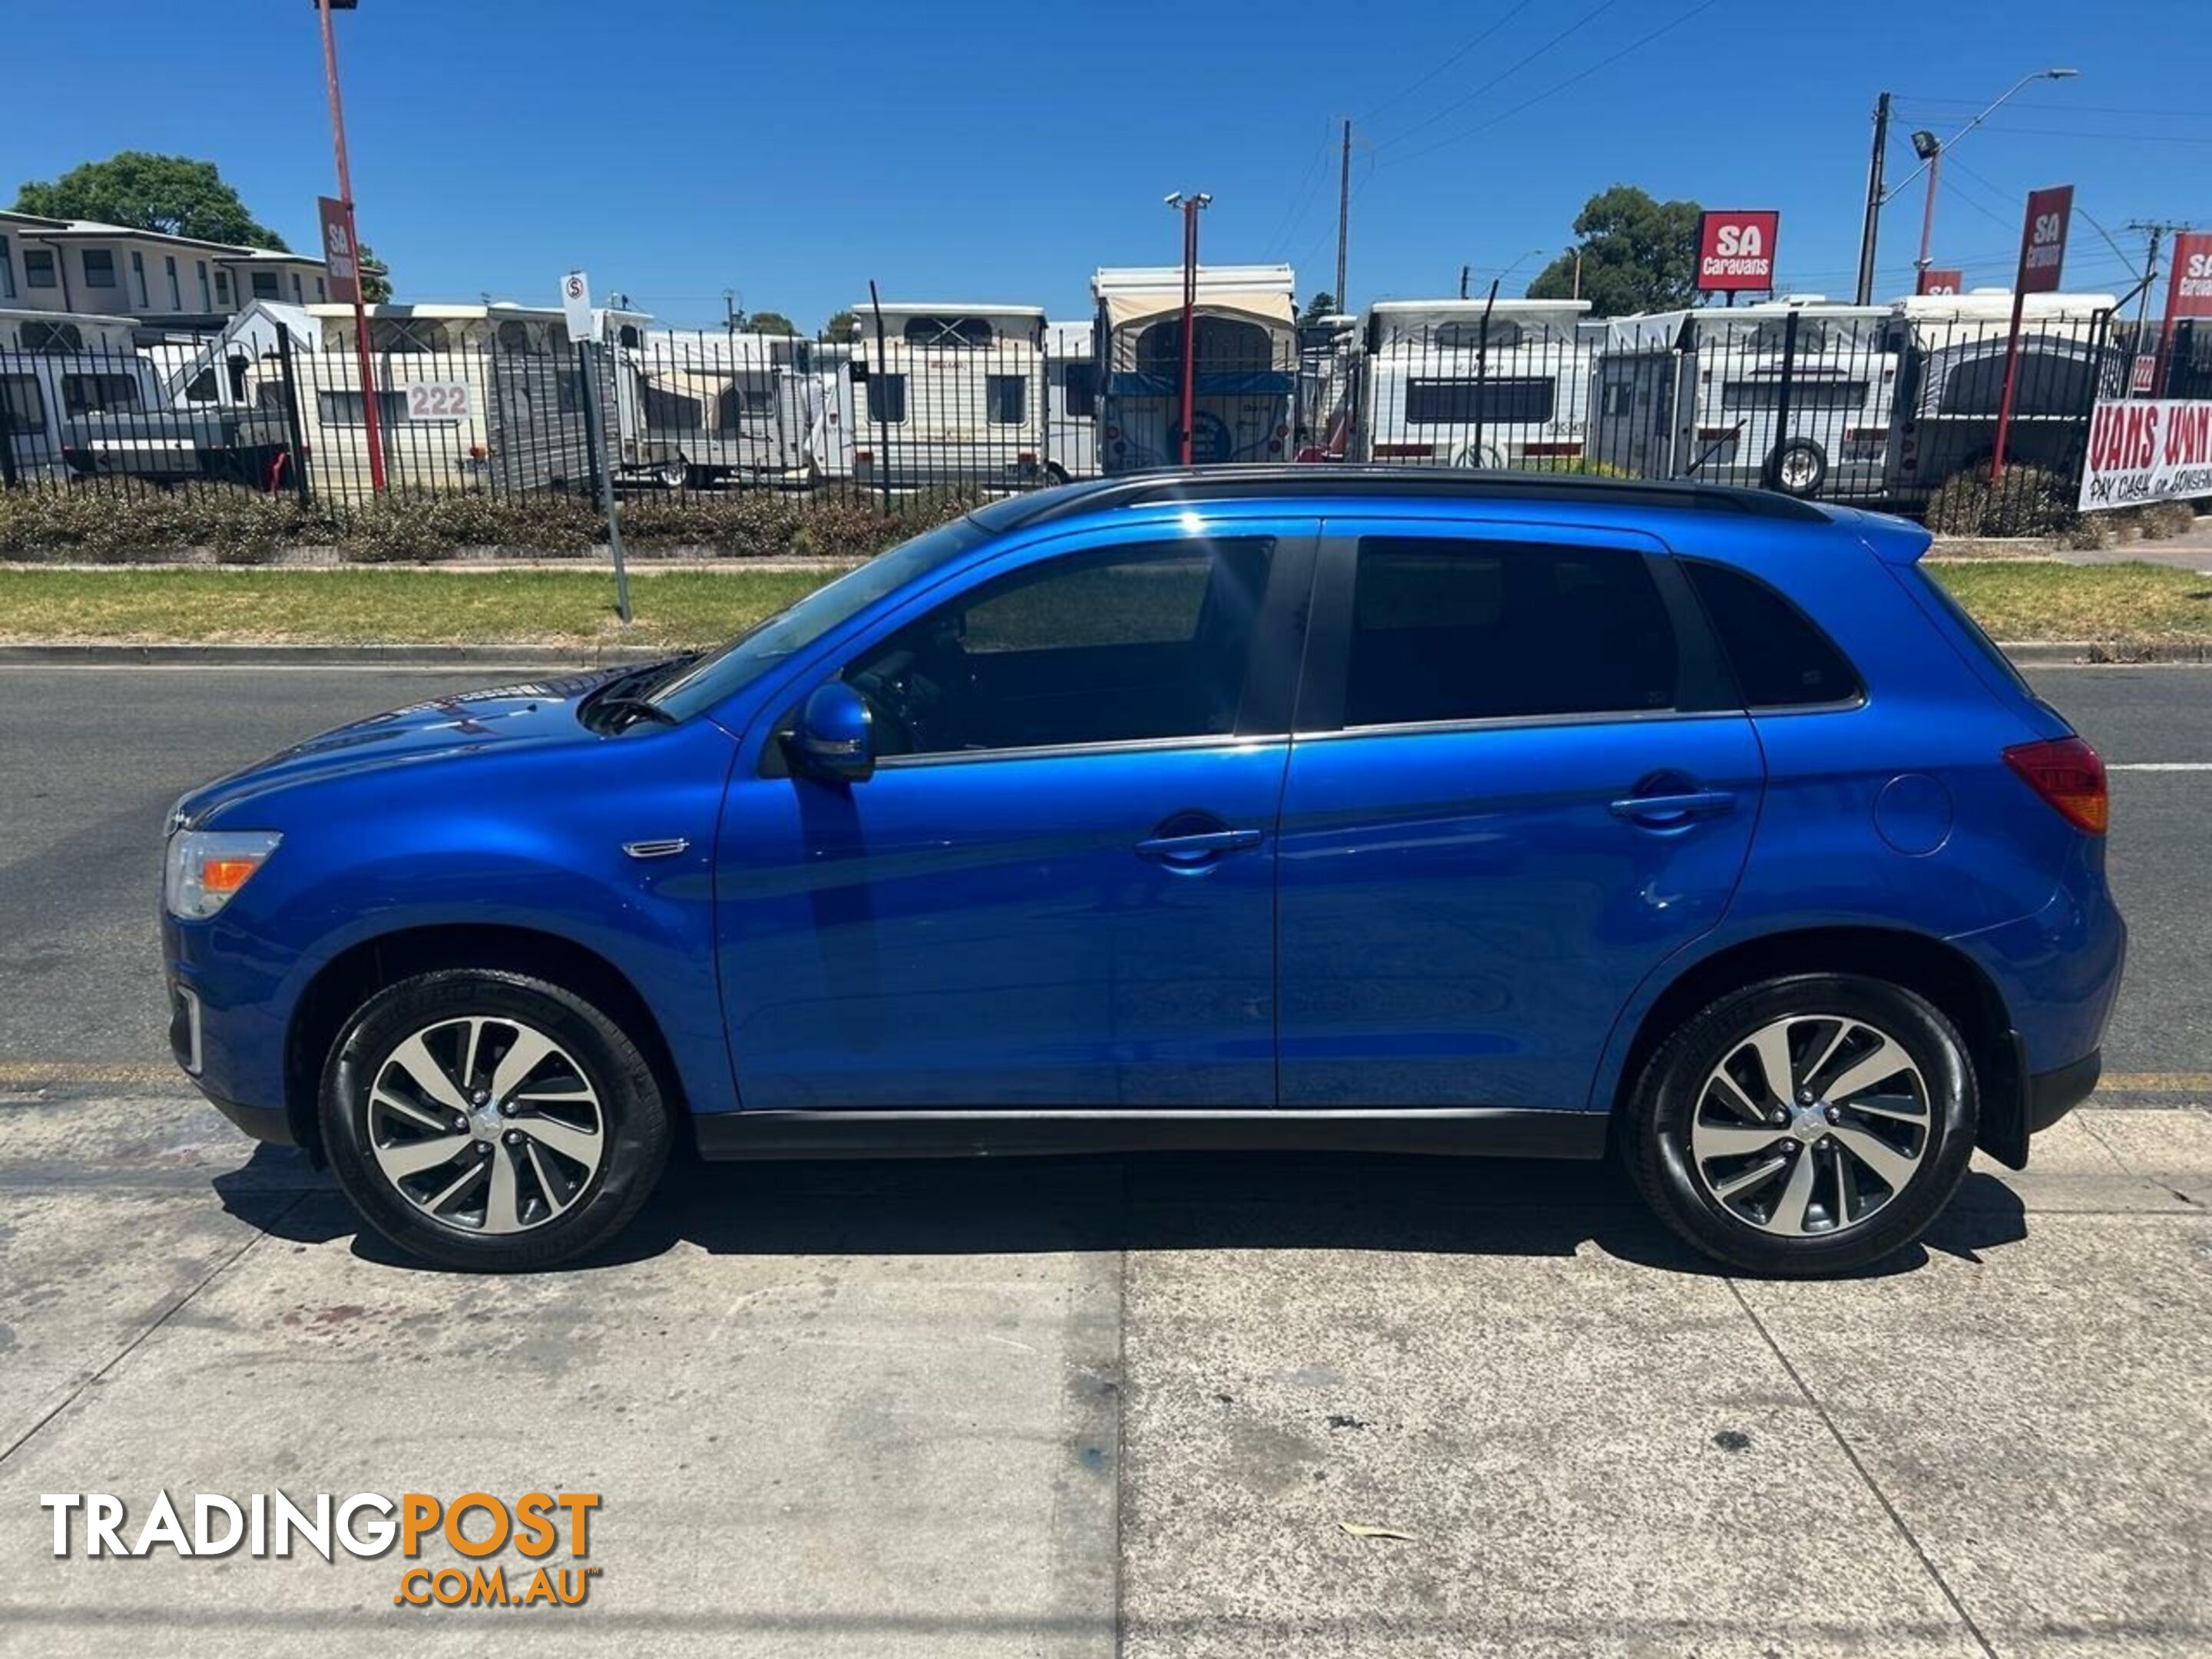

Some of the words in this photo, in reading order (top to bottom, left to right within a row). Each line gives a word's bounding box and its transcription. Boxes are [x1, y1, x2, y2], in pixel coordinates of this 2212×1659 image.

[328, 223, 349, 254] SA
[1717, 225, 1761, 257] SA
[2034, 213, 2059, 243] SA
[1704, 257, 1769, 276] Caravans
[412, 386, 467, 415] 222
[2091, 406, 2158, 472] VANS
[2164, 406, 2212, 465] WAN
